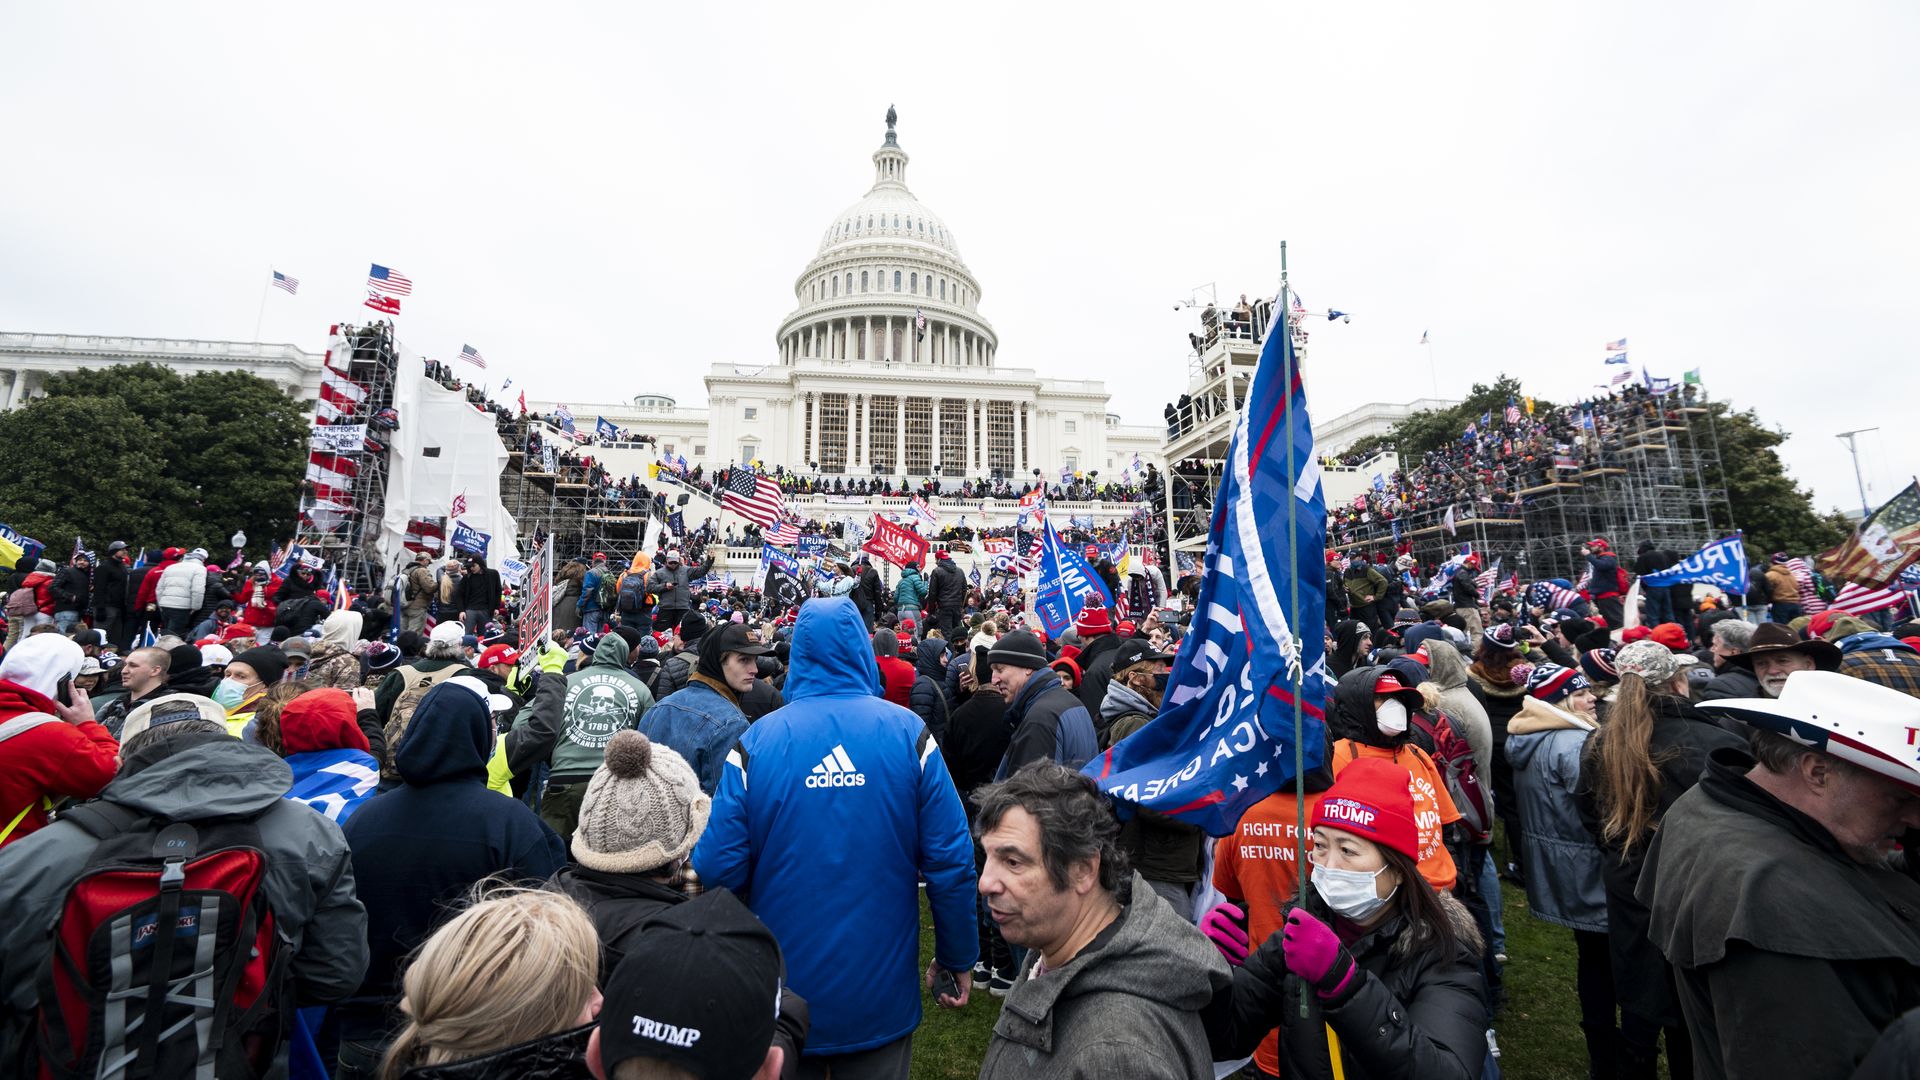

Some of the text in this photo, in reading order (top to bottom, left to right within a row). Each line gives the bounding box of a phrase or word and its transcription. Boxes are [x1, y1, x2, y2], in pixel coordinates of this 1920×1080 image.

[543, 438, 552, 473] TRUMP
[581, 674, 640, 717] AMENDMENT
[588, 722, 609, 731] 1789
[805, 771, 866, 788] adidas
[1323, 804, 1375, 826] TRUMP
[1242, 822, 1283, 838] FIGHT
[1240, 845, 1295, 862] RETURN
[632, 1014, 701, 1048] TRUMP
